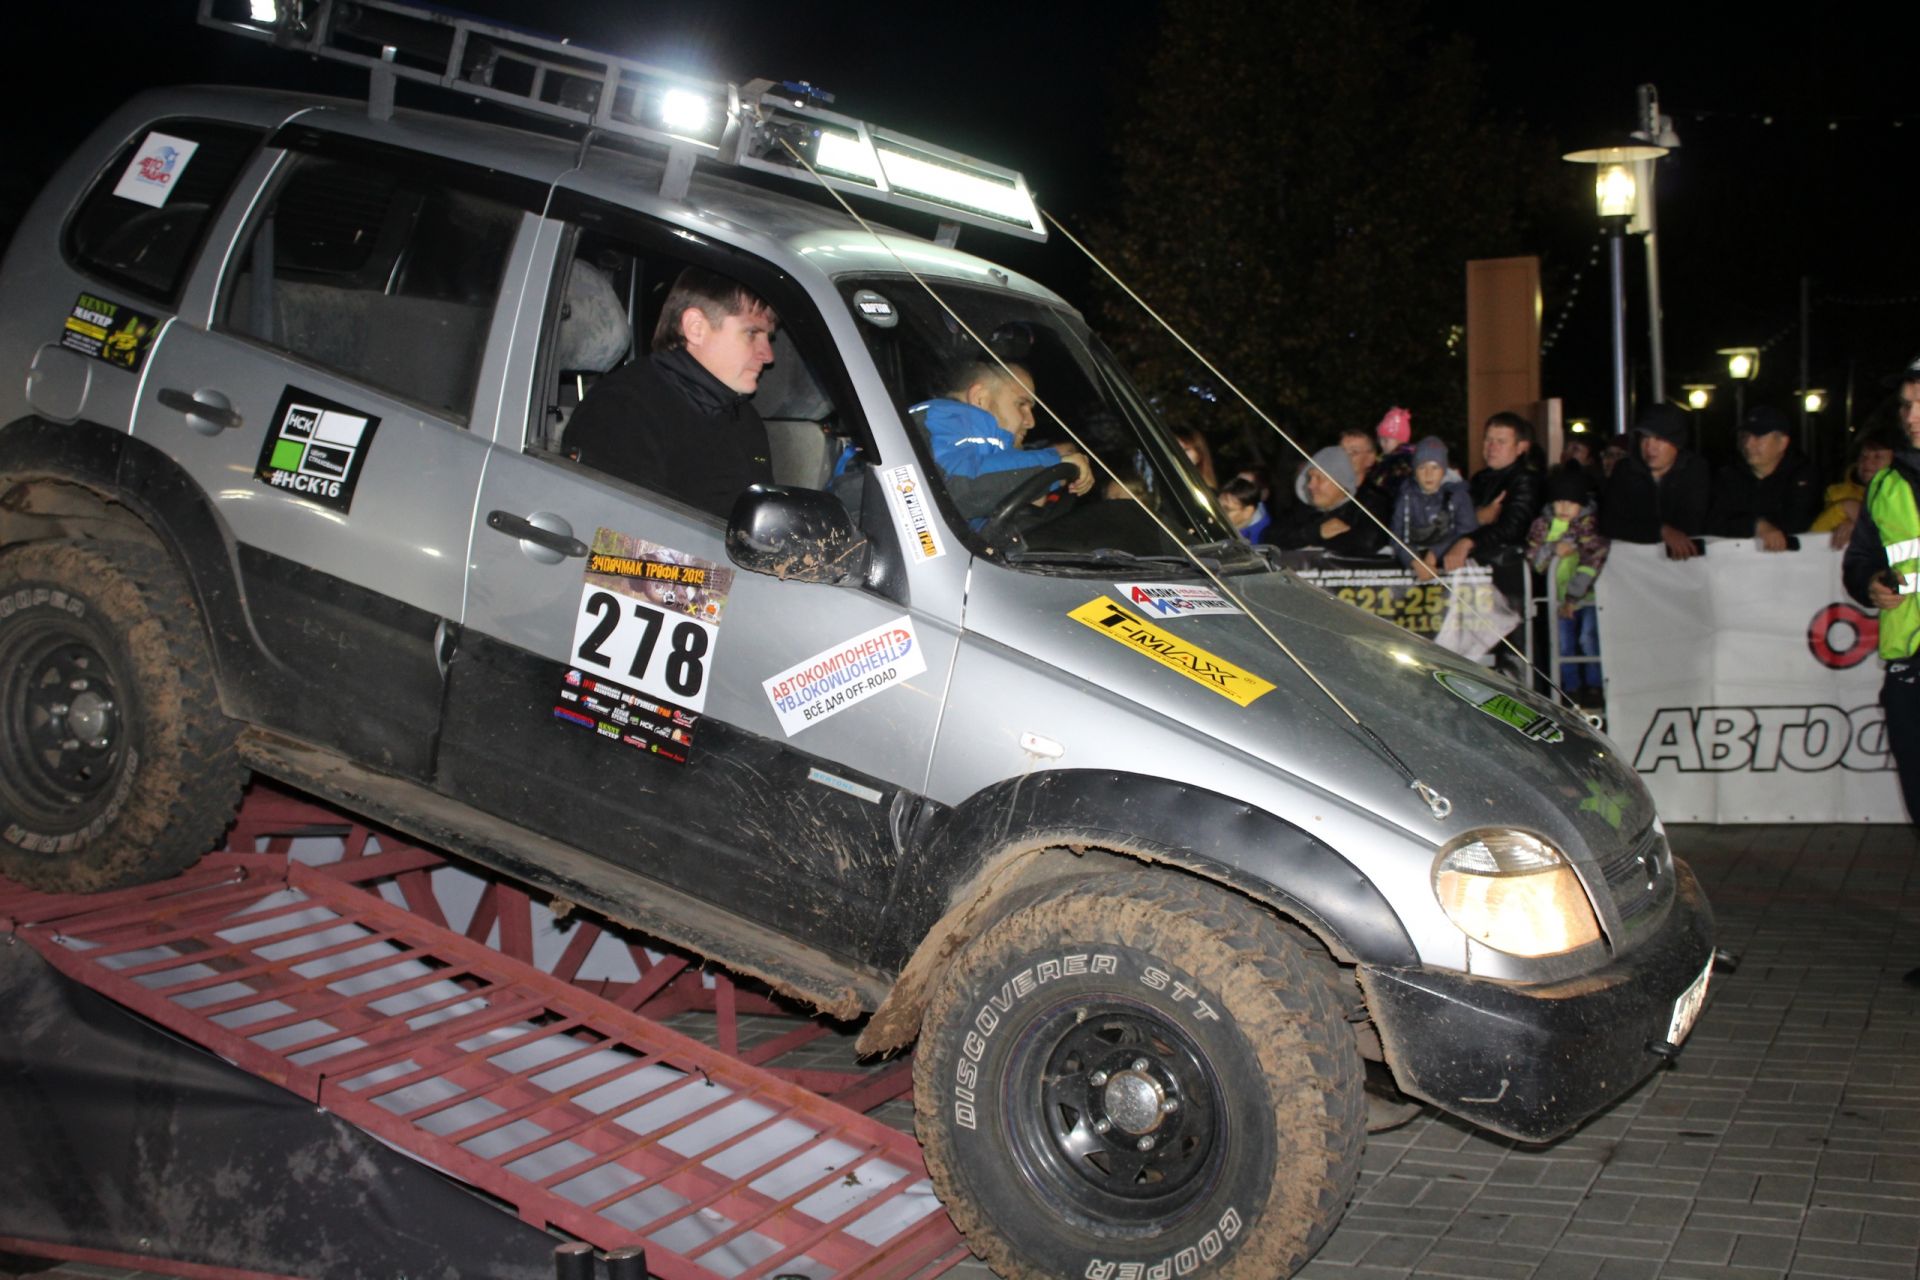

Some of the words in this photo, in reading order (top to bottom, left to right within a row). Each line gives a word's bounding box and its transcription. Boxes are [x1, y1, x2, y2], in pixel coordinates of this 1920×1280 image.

[288, 413, 314, 433] НСК
[271, 469, 341, 498] #НСК16
[645, 563, 679, 581] ТРОФИ
[578, 592, 708, 697] 278
[771, 631, 893, 701] АВТОКОМПОНЕНТ
[1099, 604, 1238, 686] T-MAX
[803, 701, 825, 721] ВСЁ
[825, 692, 845, 713] ДЛЯ
[845, 667, 898, 700] OFF-ROAD
[1633, 704, 1896, 773] АВТОС
[955, 954, 1117, 1130] DISCOVERER
[1140, 966, 1220, 1024] STT
[1085, 1206, 1242, 1280] COOPER
